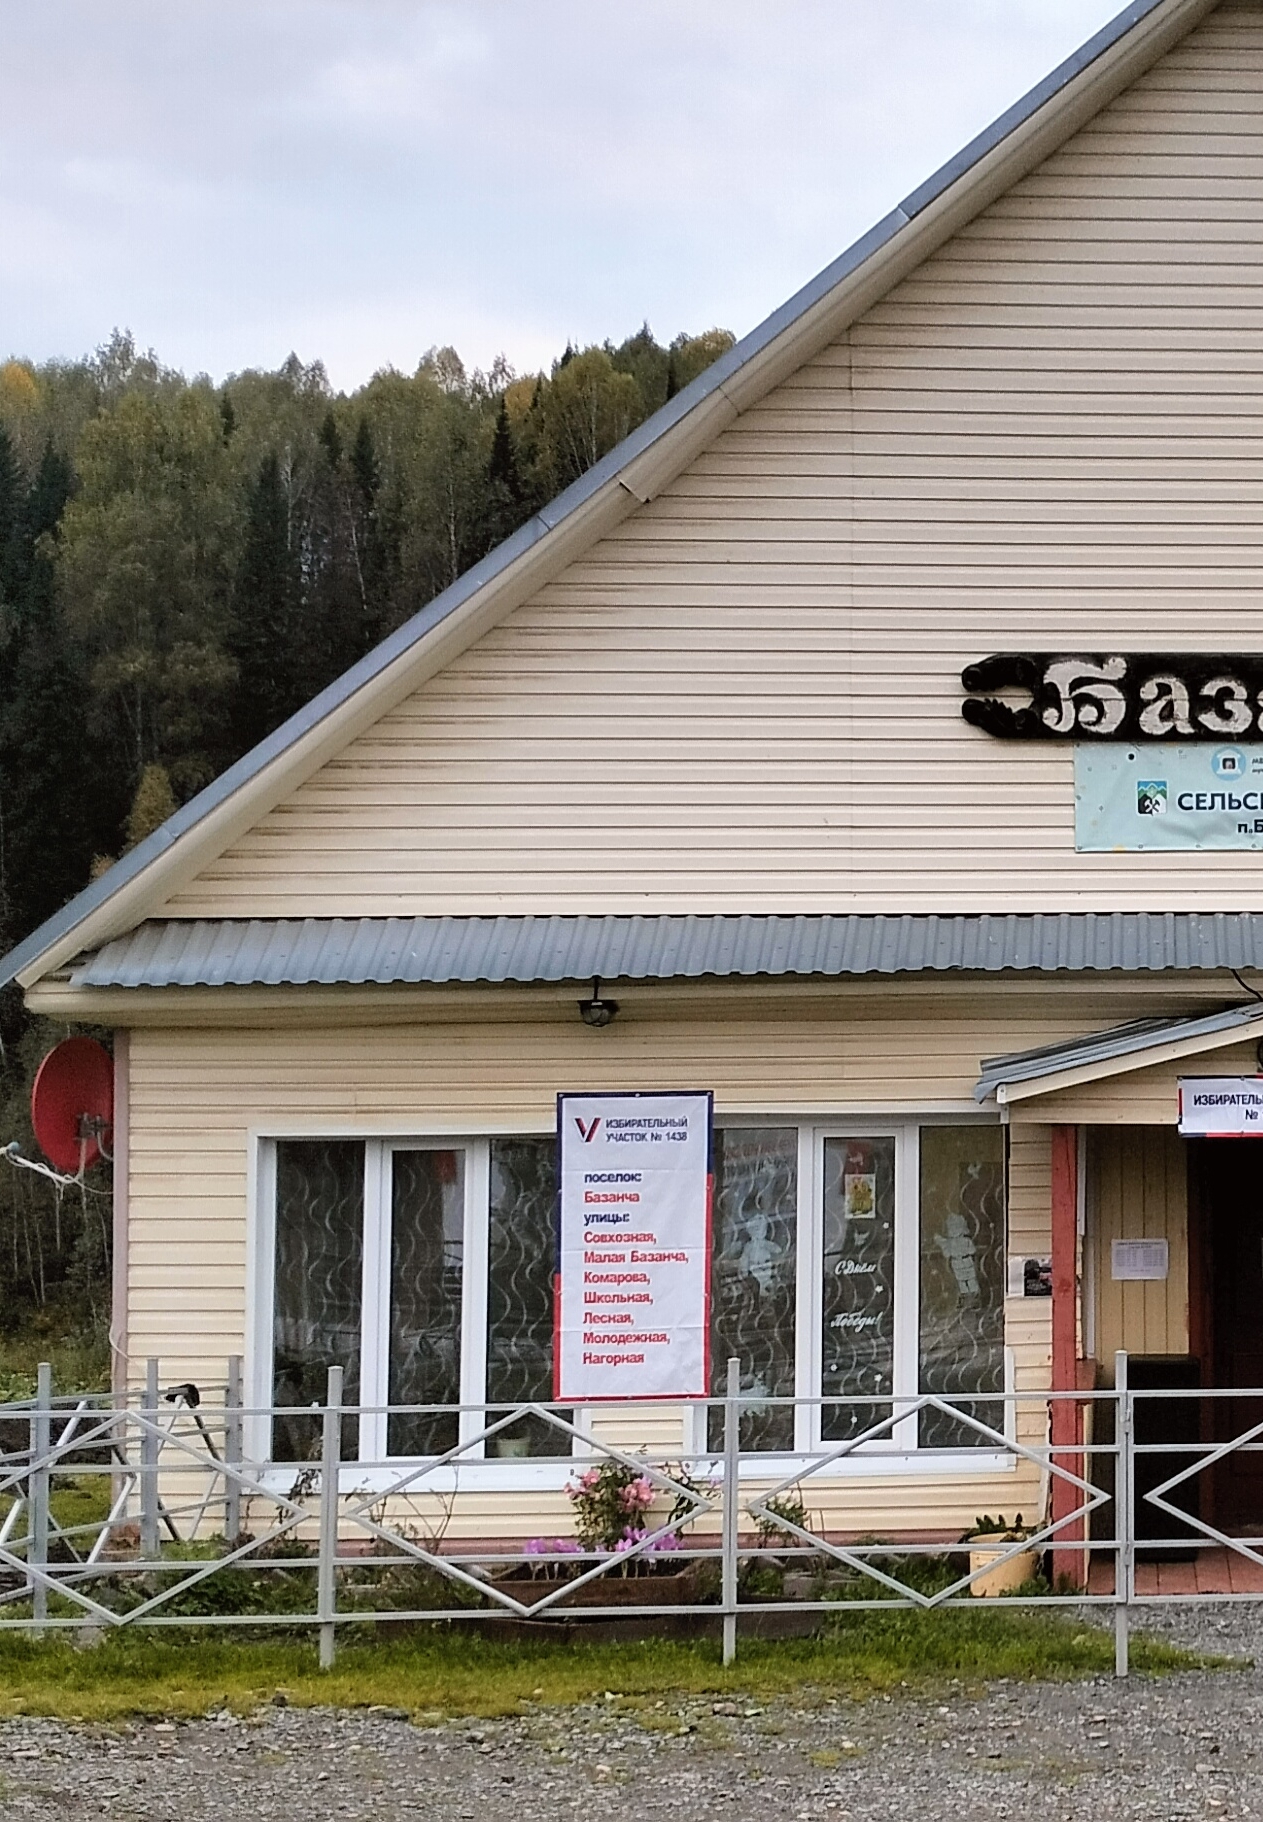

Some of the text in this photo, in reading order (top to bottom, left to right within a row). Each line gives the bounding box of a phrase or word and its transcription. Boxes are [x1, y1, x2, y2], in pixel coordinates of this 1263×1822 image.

[1245, 1109, 1259, 1120] №
[606, 1115, 688, 1129] ИЗБИРАТЕЛЬНЫЙ
[606, 1131, 688, 1143] УЧАСТОК № 1438
[584, 1191, 640, 1203] Базанча
[584, 1212, 630, 1226] улицы:
[584, 1231, 657, 1244] Совхозная,
[584, 1250, 689, 1264] Малая Базанча,
[584, 1271, 651, 1286] Комарова,
[584, 1291, 654, 1305] Школьная,
[583, 1311, 635, 1325] Лесная,
[583, 1332, 671, 1345] Молодежная,
[583, 1352, 645, 1366] Нагорная
